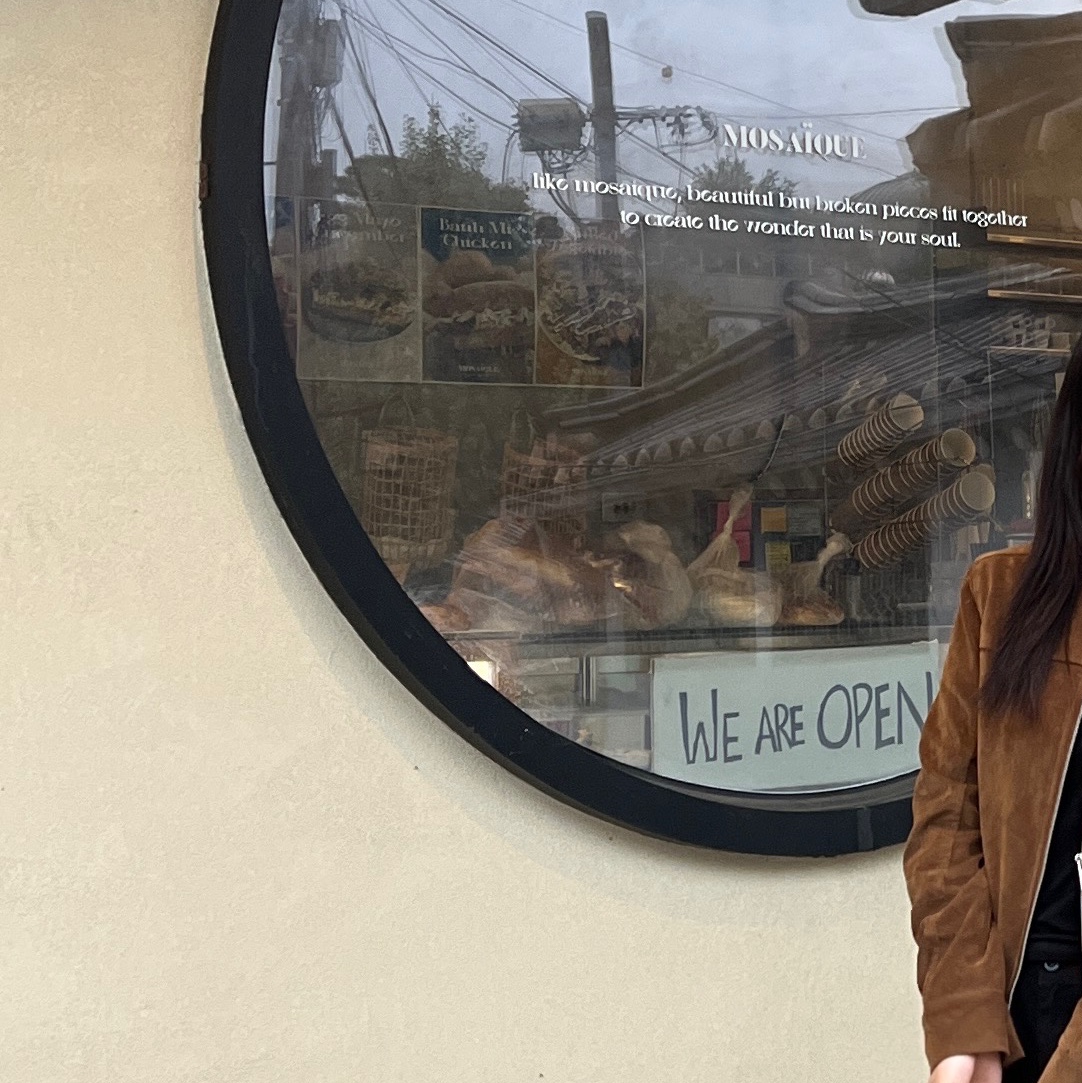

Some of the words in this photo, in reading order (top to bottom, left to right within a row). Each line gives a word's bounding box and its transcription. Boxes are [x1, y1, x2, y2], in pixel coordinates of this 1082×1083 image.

[723, 122, 867, 161] MOSAÏQUE
[532, 172, 569, 192] like
[687, 185, 774, 207] beautiful
[779, 193, 811, 212] but
[815, 197, 878, 217] broken
[882, 204, 938, 222] pieces
[942, 206, 958, 223] fit
[962, 209, 1028, 229] together
[439, 218, 485, 233] Banh
[442, 233, 514, 251] Chicken
[621, 209, 640, 226] to
[645, 213, 704, 229] create
[709, 214, 738, 233] the
[745, 219, 816, 238] wonder
[820, 220, 855, 241] that
[859, 225, 874, 242] is
[877, 229, 917, 248] your
[919, 231, 961, 248] soul.
[680, 689, 743, 765] WE
[755, 703, 806, 756] ARE
[817, 672, 934, 751] OPEN
